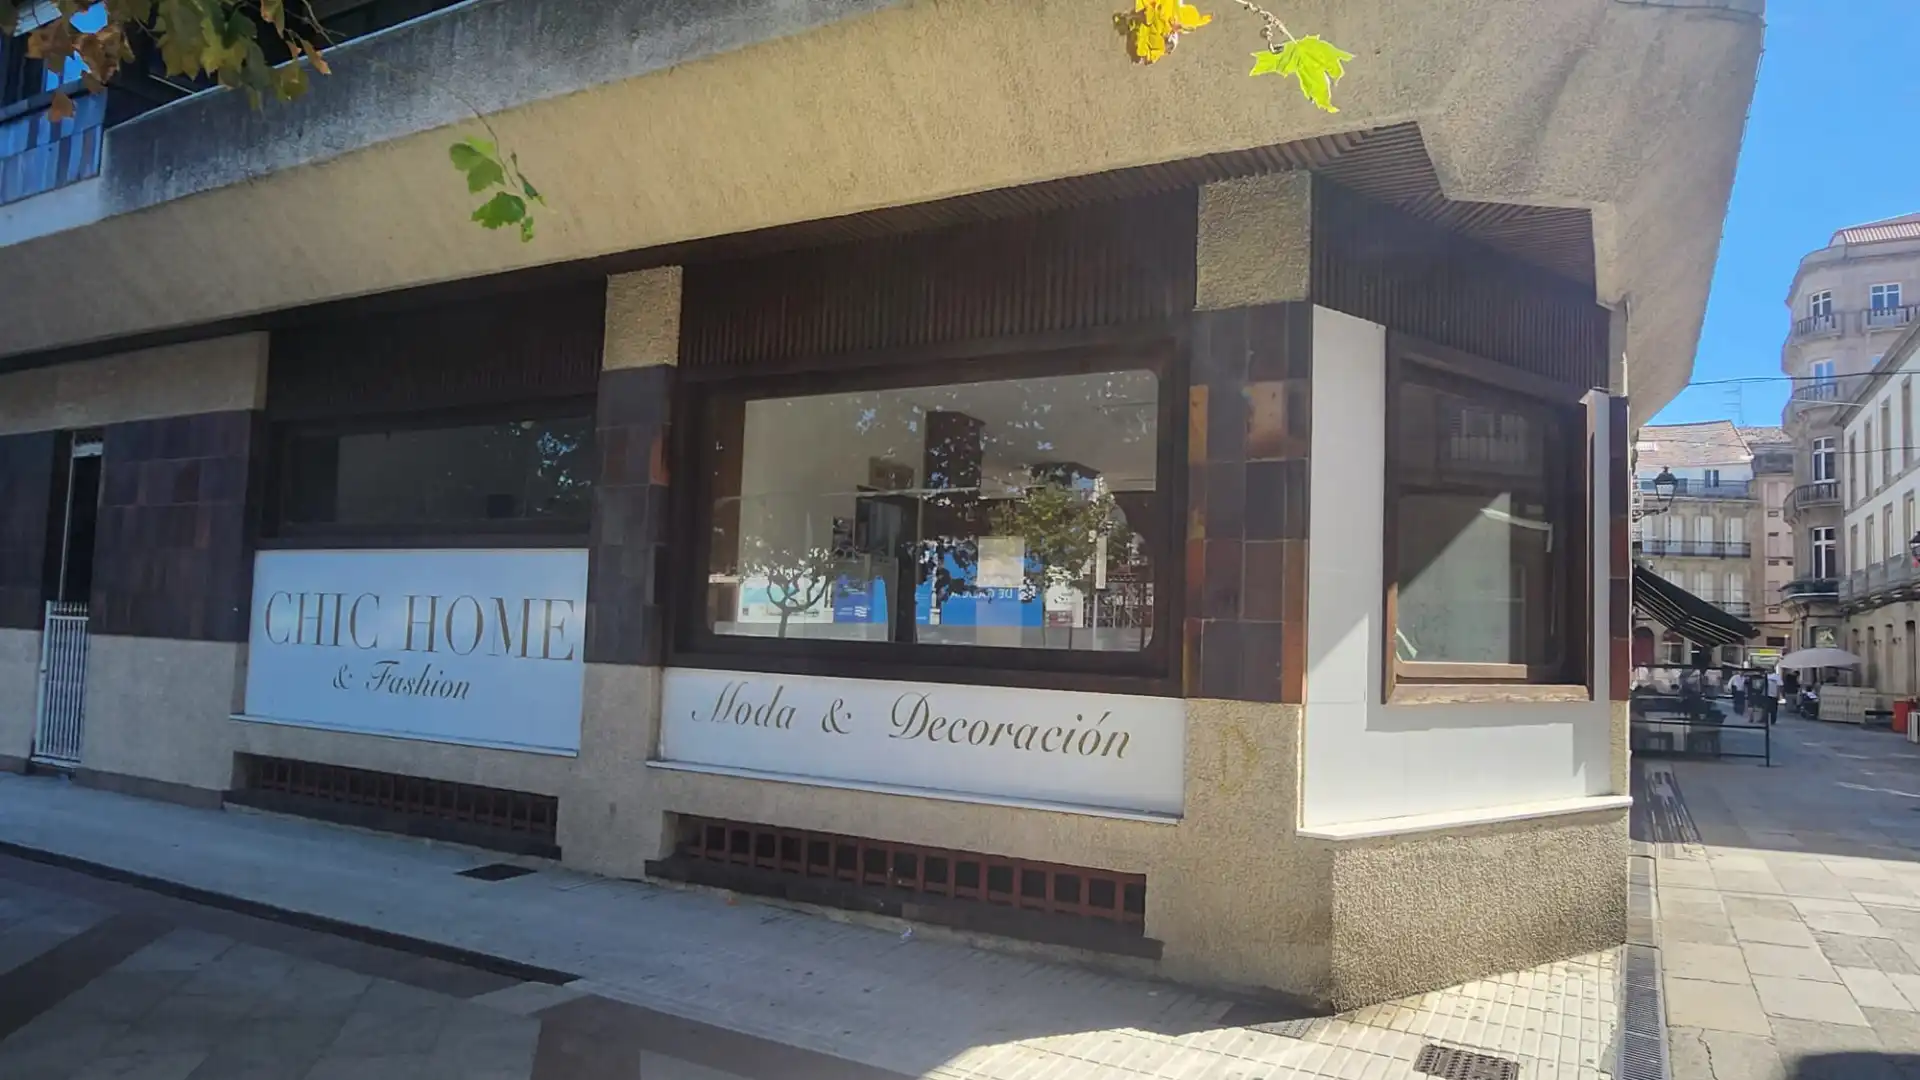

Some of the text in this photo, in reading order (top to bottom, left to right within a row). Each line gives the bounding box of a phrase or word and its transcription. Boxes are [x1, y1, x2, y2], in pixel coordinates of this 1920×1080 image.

[265, 591, 575, 661] CHIC HOME
[332, 660, 471, 700] & Fashion
[691, 681, 1131, 759] Moda & Decoración
